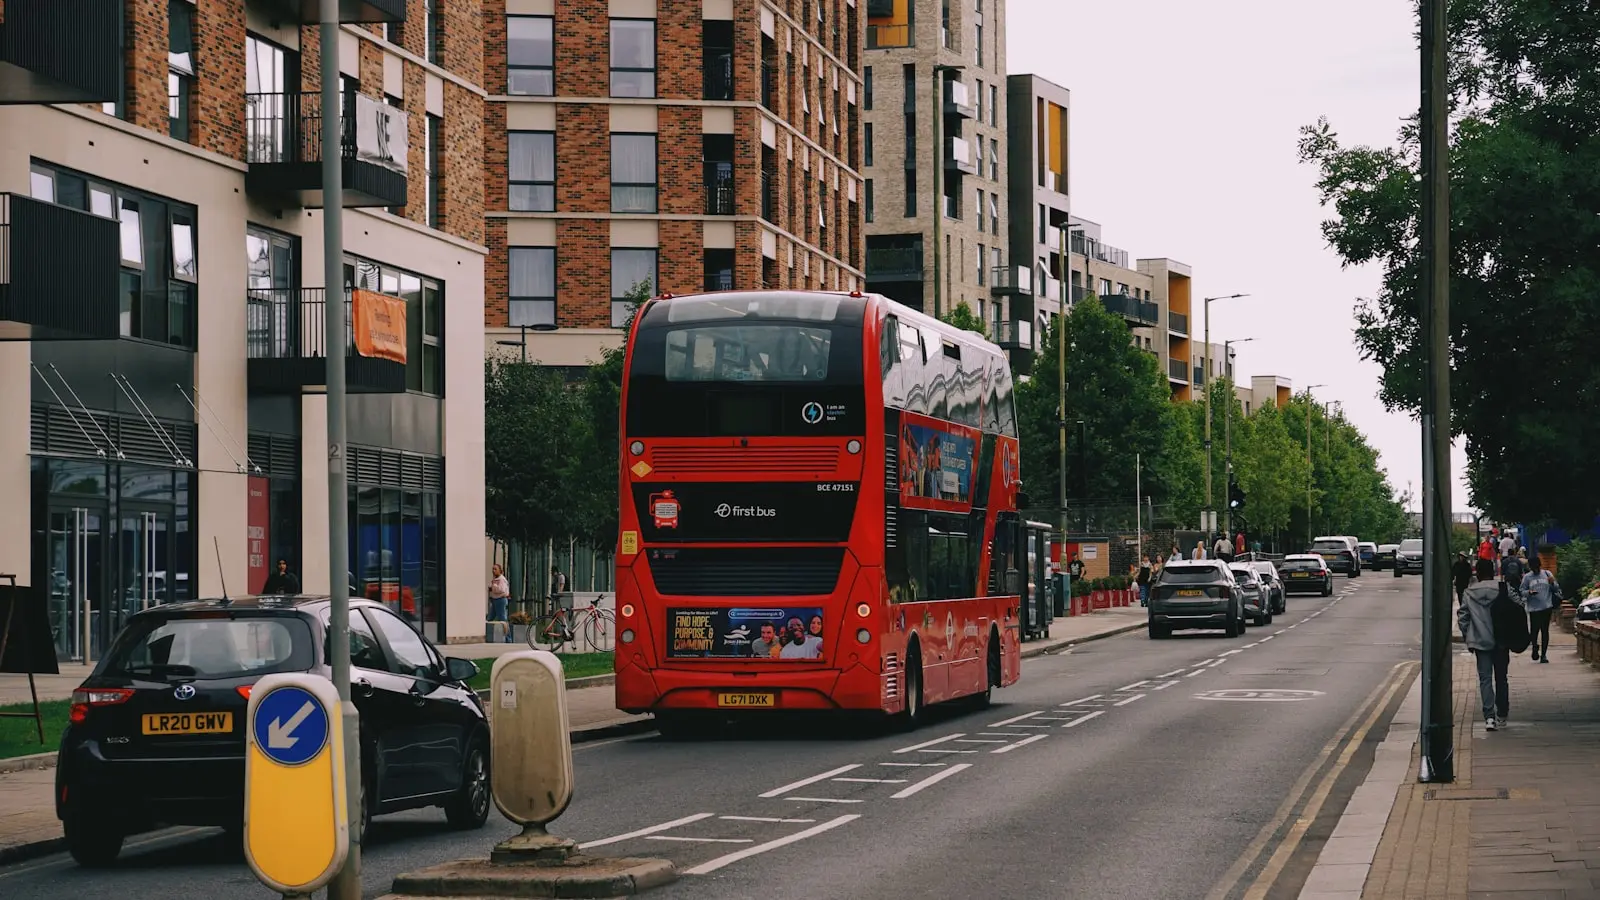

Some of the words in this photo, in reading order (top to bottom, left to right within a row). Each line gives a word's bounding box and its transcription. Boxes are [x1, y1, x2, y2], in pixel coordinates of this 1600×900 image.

[330, 444, 339, 457] 2
[816, 484, 831, 492] BCE
[832, 484, 854, 492] 47151
[732, 505, 756, 517] first
[756, 505, 776, 517] bus
[675, 615, 691, 628] FIND
[673, 638, 714, 651] COMMUNITY
[724, 694, 747, 705] LG71
[748, 694, 768, 705] DXK
[148, 715, 191, 732] LR20
[195, 713, 227, 731] GWV
